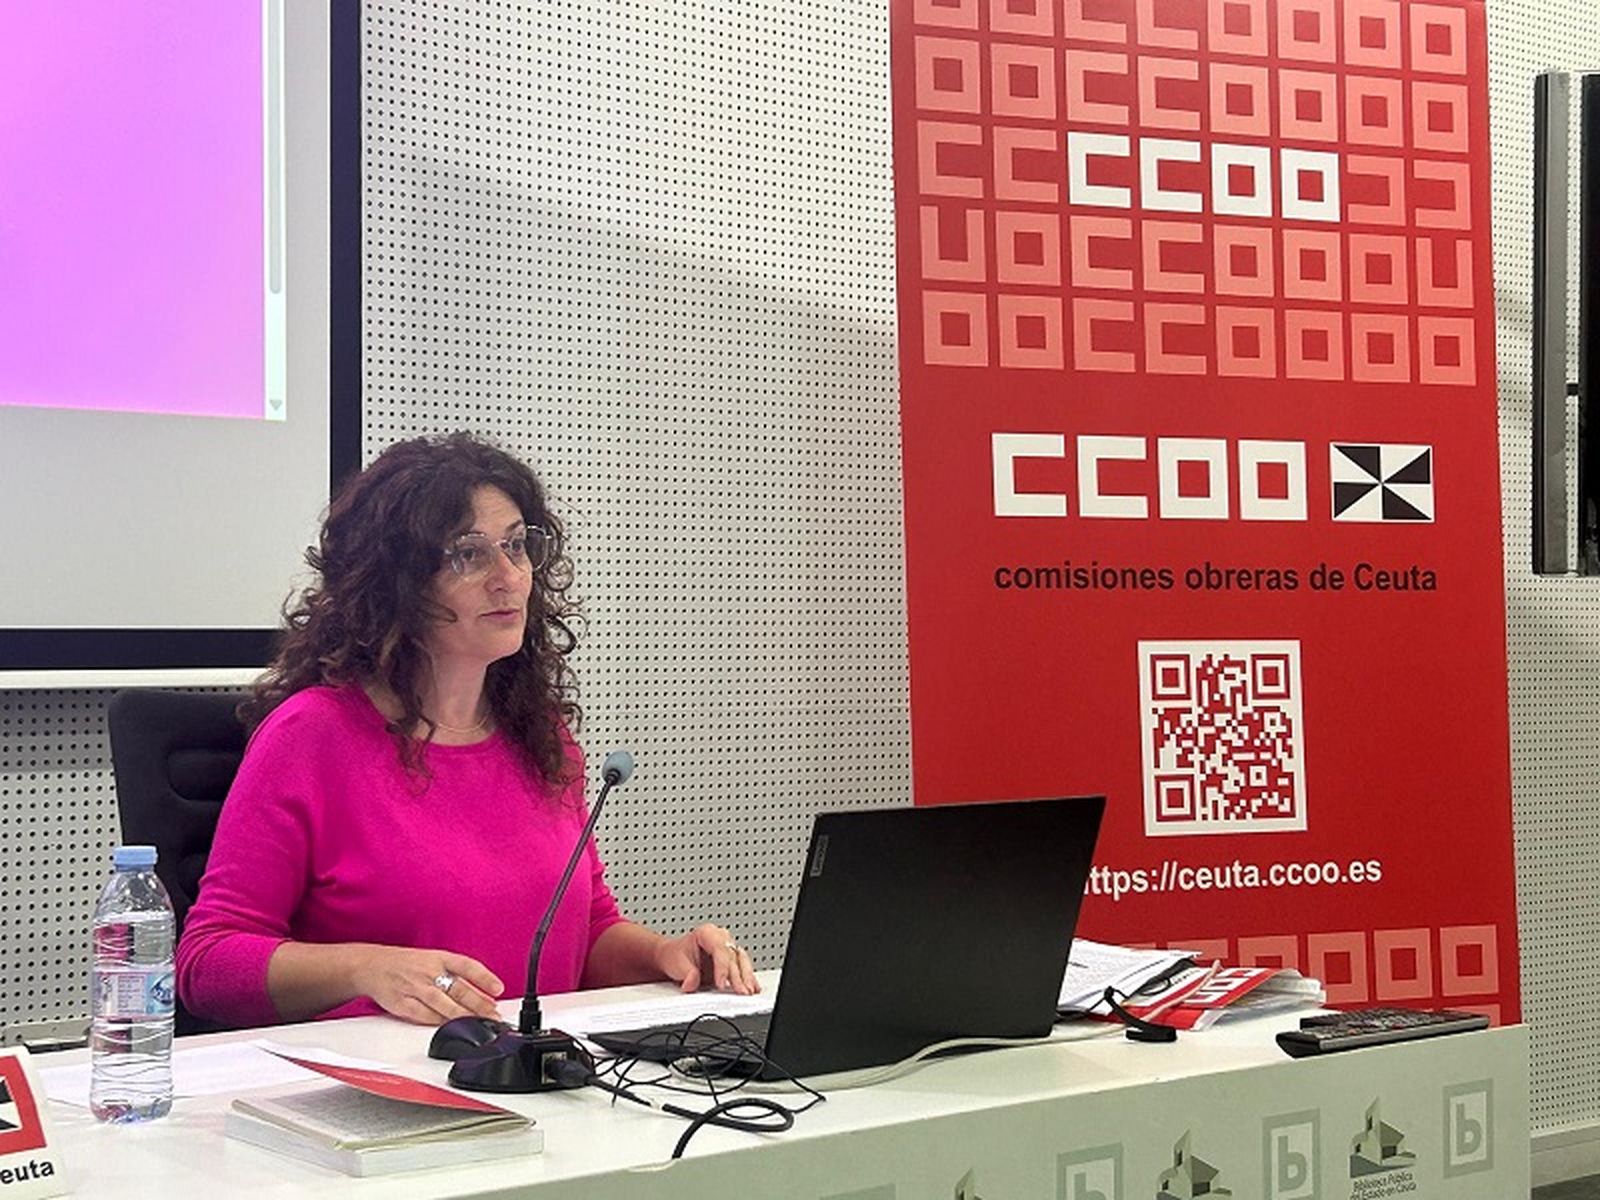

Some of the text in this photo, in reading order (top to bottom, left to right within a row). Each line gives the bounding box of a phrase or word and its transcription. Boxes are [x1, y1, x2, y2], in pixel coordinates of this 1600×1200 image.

[1068, 132, 1340, 222] CCOO
[992, 433, 1308, 521] CCOO
[994, 560, 1437, 591] comisiones obreras de Ceuta
[1084, 859, 1383, 901] ttps://ceuta.ccoo.es
